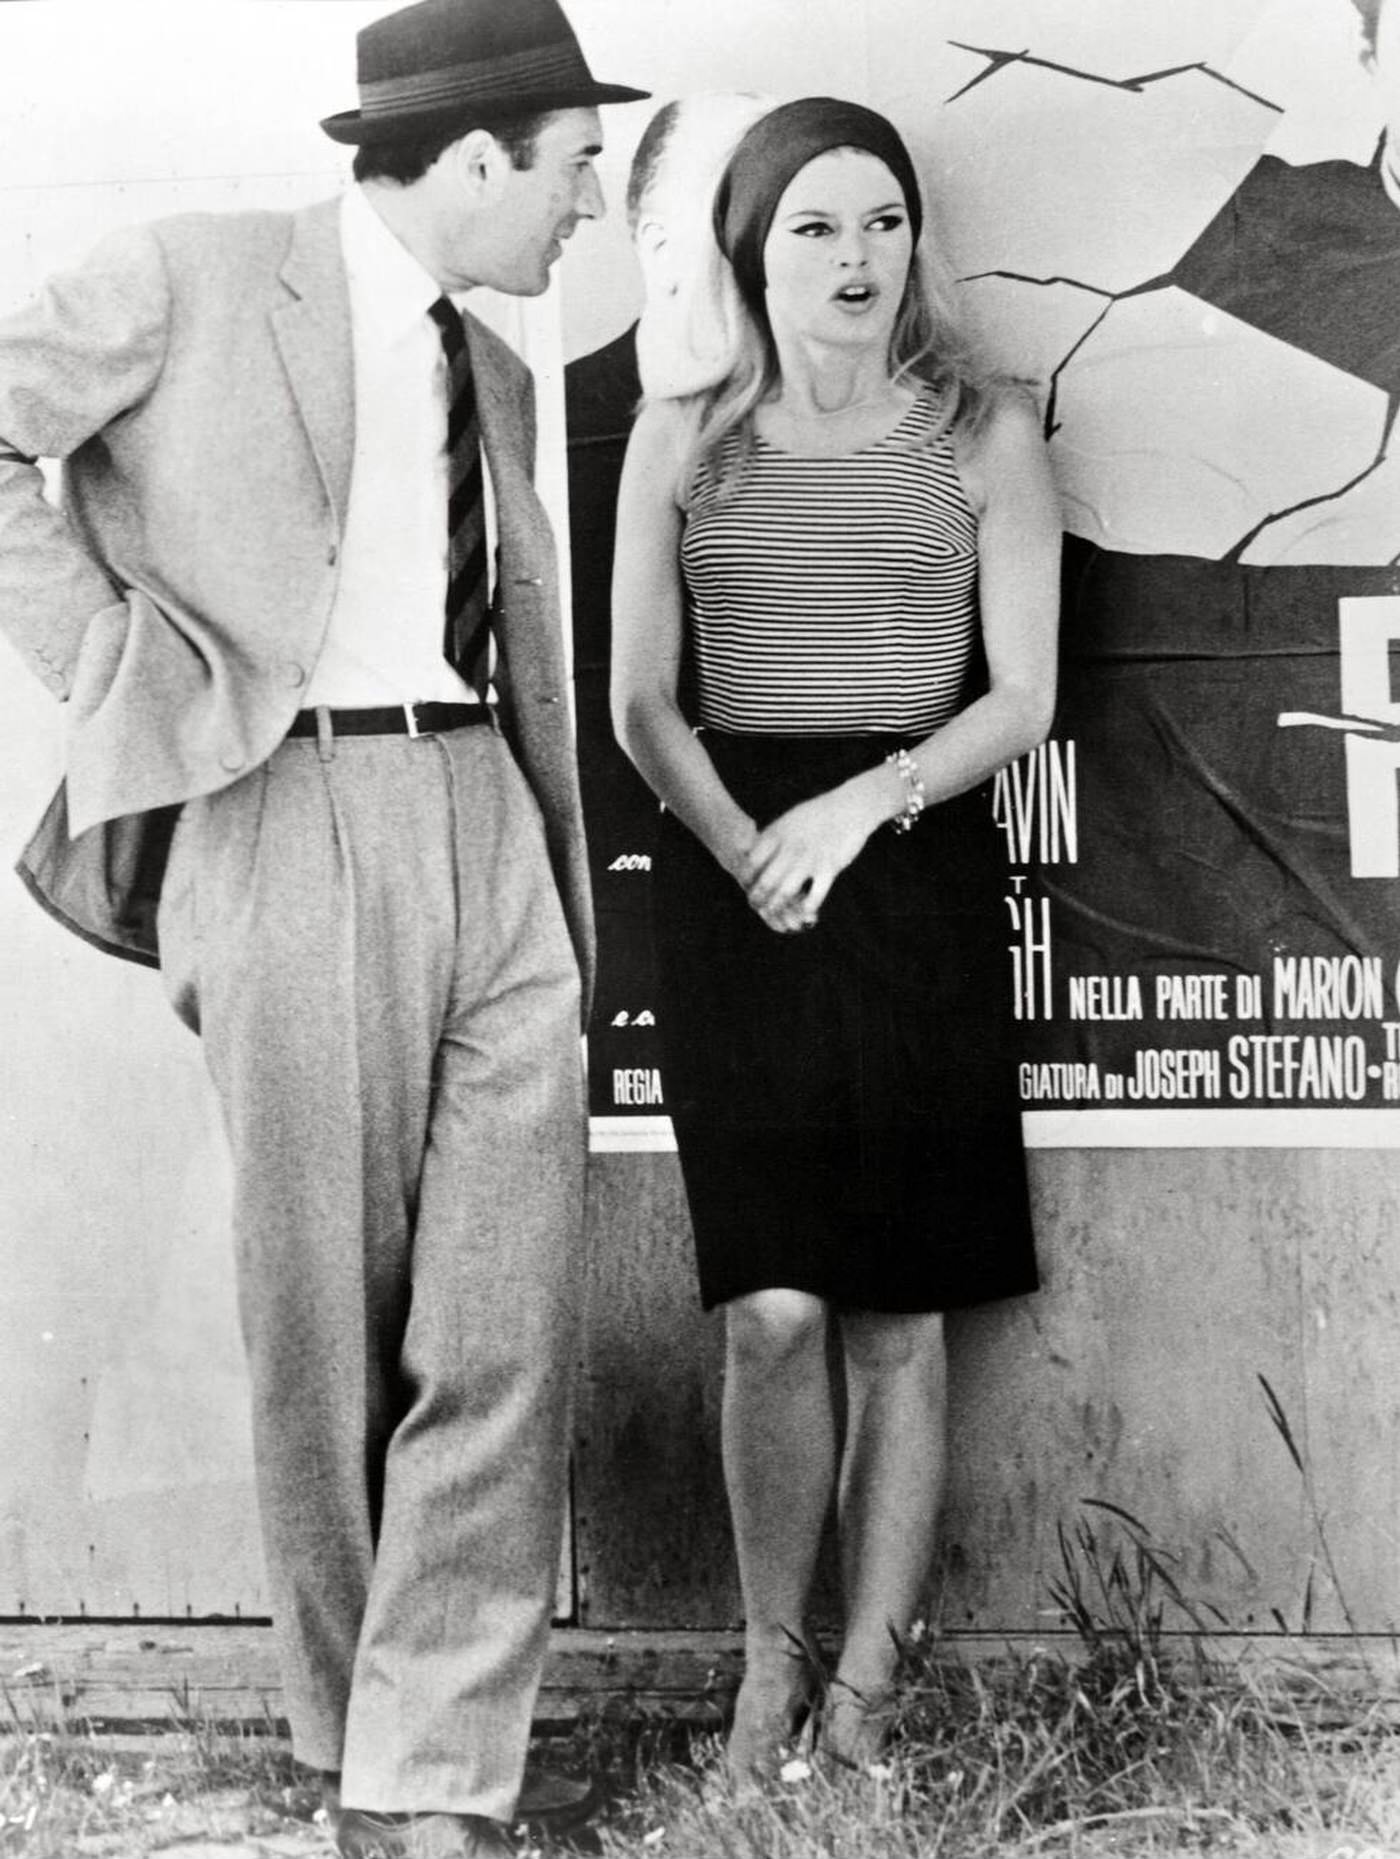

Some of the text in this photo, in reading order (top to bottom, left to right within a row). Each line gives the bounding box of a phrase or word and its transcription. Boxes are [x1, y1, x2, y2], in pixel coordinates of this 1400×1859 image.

[1069, 975, 1144, 1021] NELLA
[1156, 974, 1229, 1020] PARTE
[1236, 974, 1262, 1020] DI
[1273, 955, 1384, 1020] MARION
[613, 1068, 664, 1105] REGIA
[1019, 1062, 1101, 1100] GIATURA
[1104, 1073, 1124, 1100] DI
[1127, 1049, 1221, 1100] JOSEPH
[1228, 1035, 1367, 1100] STEFANO
